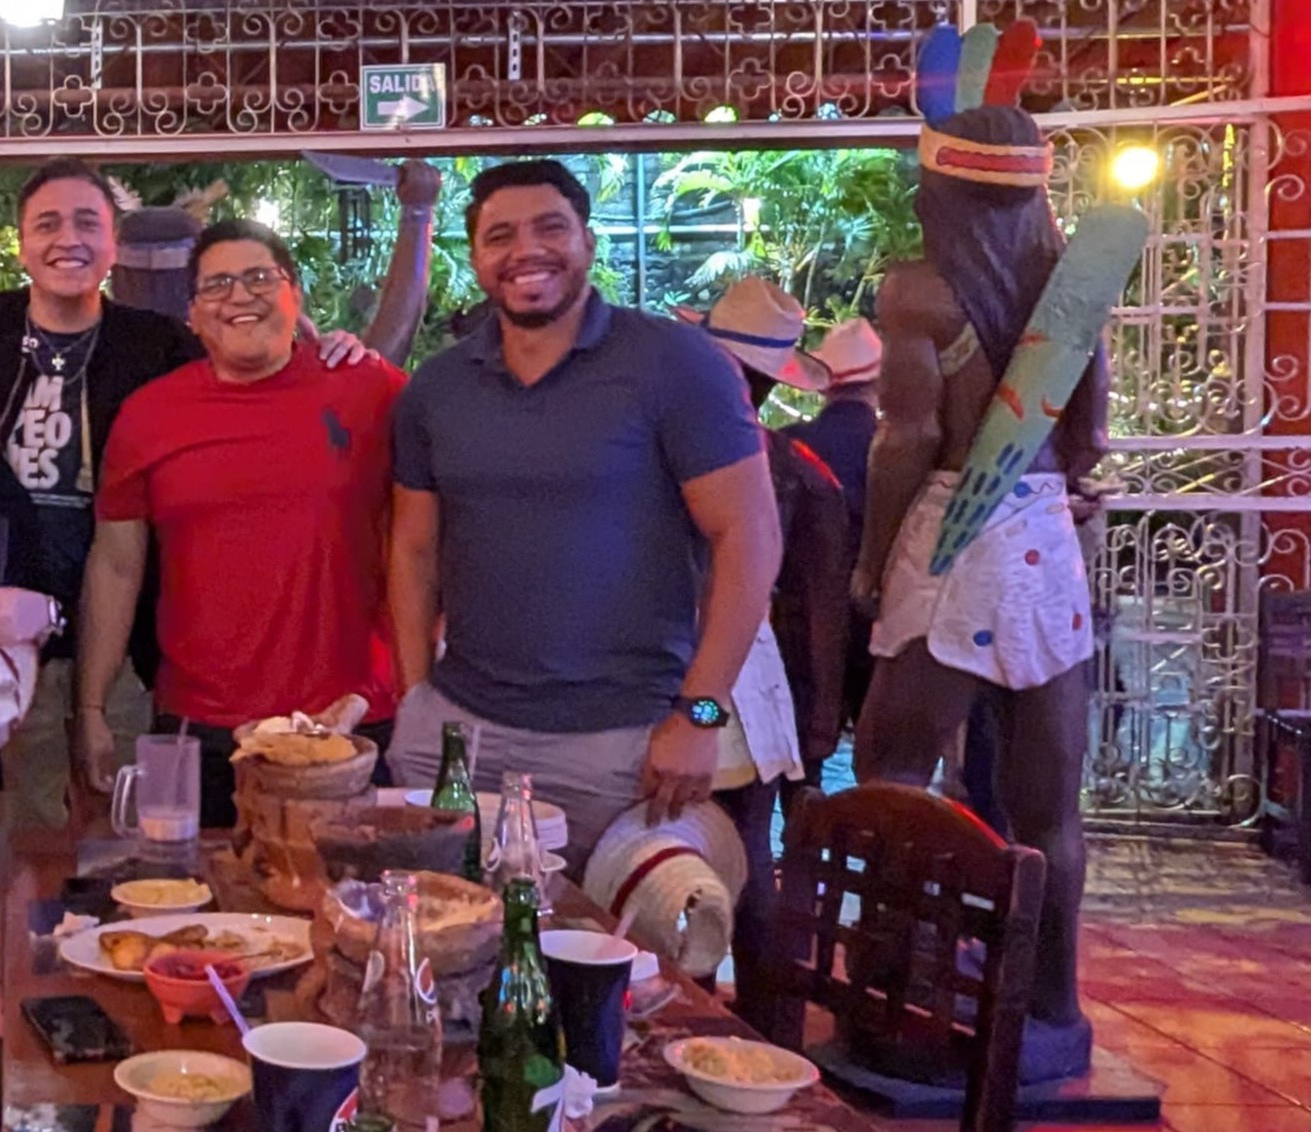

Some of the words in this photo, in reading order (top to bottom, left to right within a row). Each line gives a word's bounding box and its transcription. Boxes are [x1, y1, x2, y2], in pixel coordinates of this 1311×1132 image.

[369, 74, 436, 94] SALIDA
[25, 374, 65, 412] M
[15, 408, 72, 449] EO
